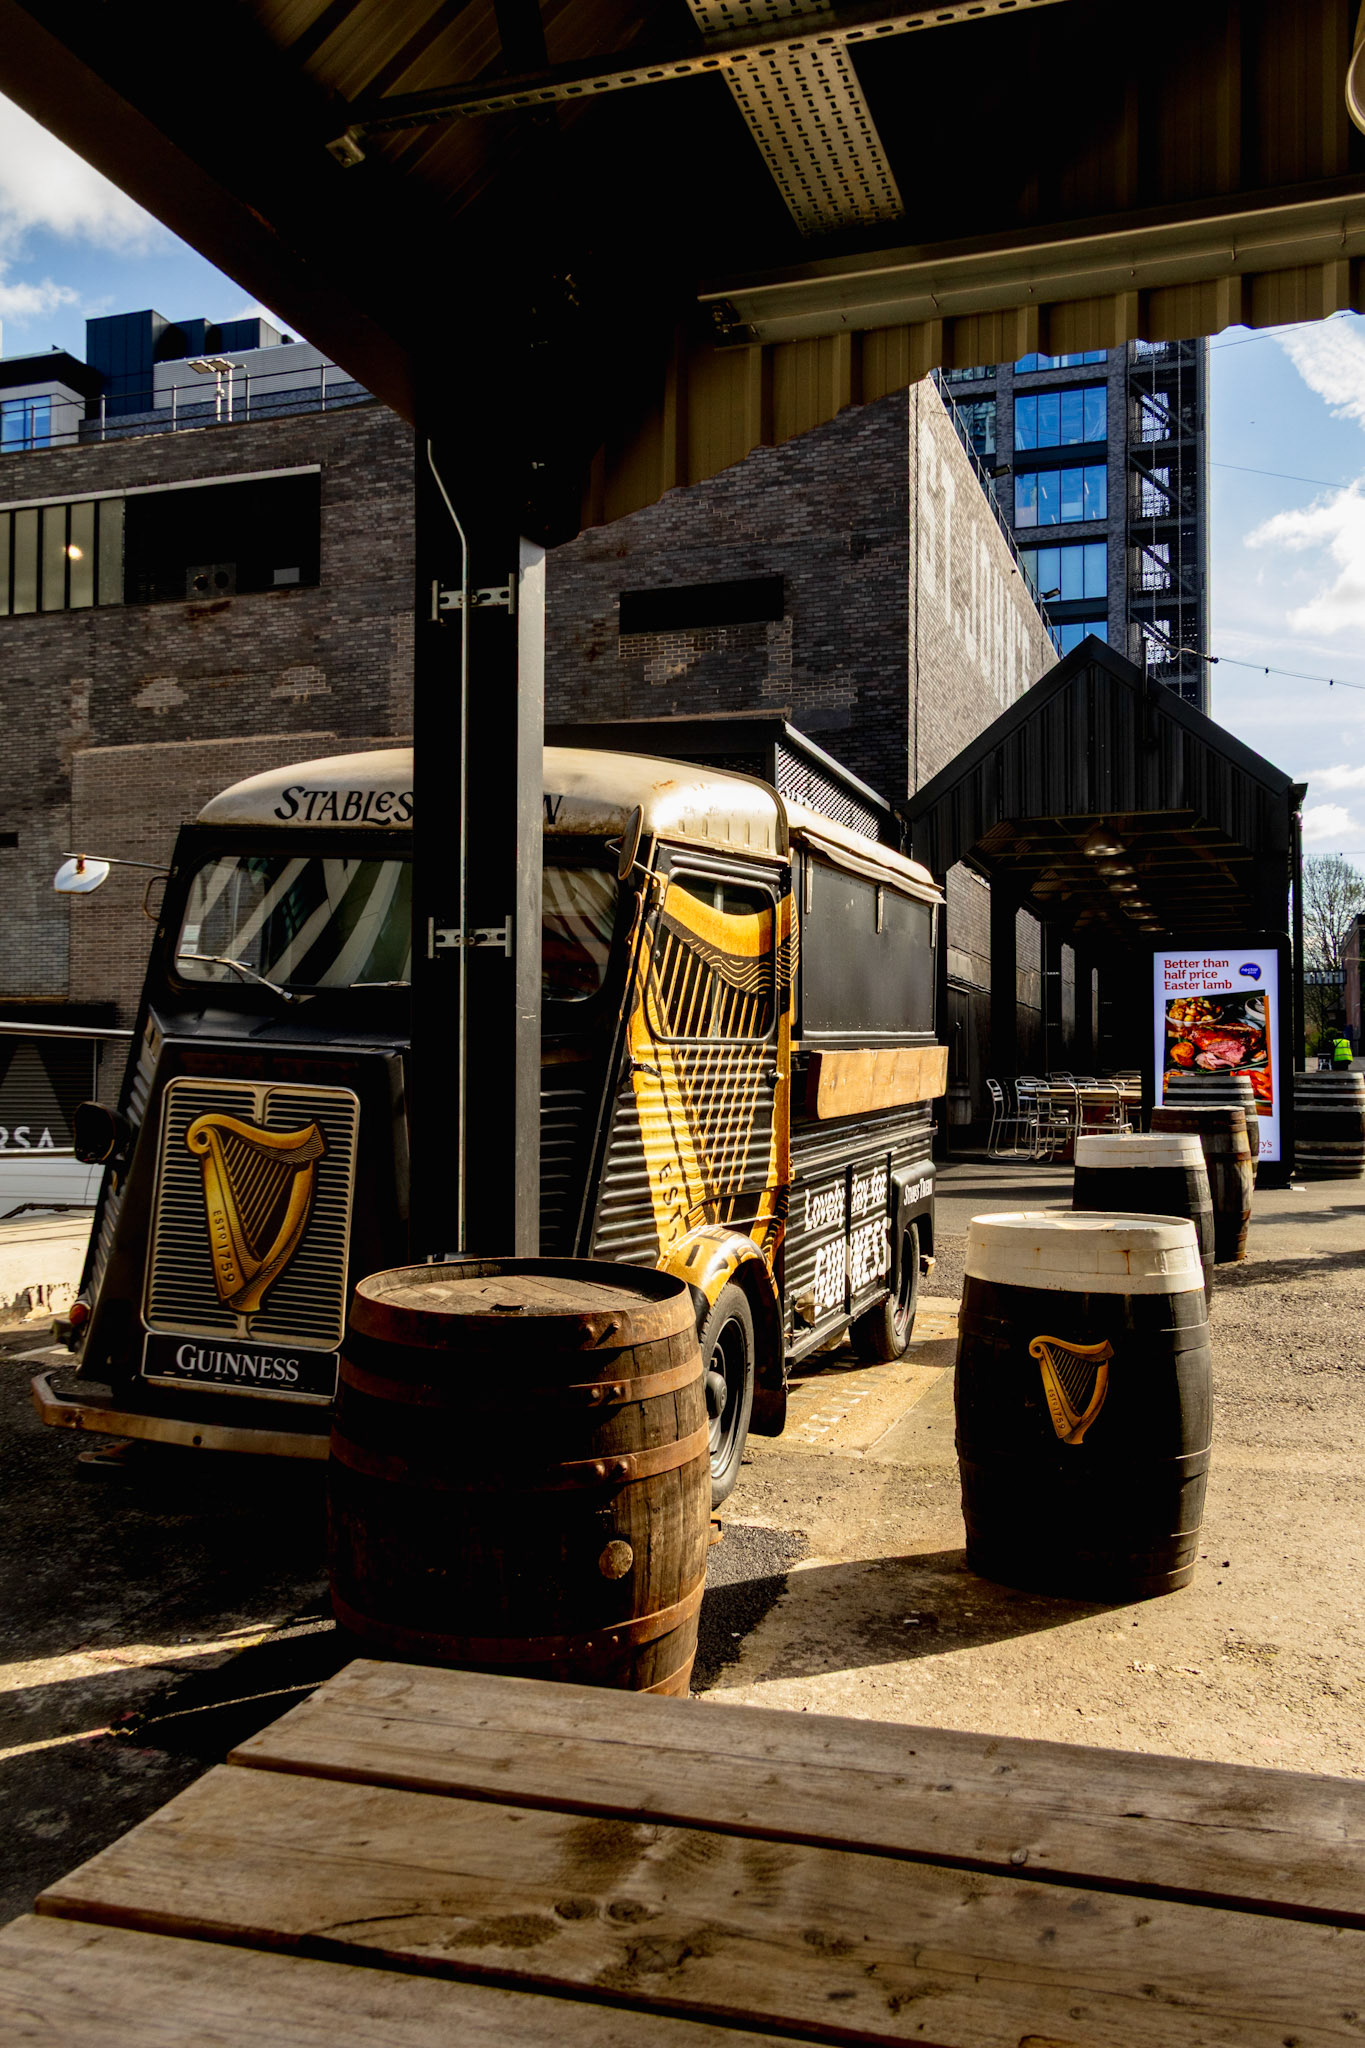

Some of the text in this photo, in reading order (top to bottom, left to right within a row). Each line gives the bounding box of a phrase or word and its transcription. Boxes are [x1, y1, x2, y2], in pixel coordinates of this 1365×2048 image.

[1164, 958, 1229, 969] Better than
[1164, 969, 1218, 981] half price
[1164, 979, 1232, 990] Easter lamb
[804, 1179, 846, 1232] Lovely
[871, 1166, 888, 1204] for
[217, 1244, 236, 1283] 1759
[175, 1343, 300, 1383] GUINNESS
[1053, 1407, 1067, 1430] 1759
